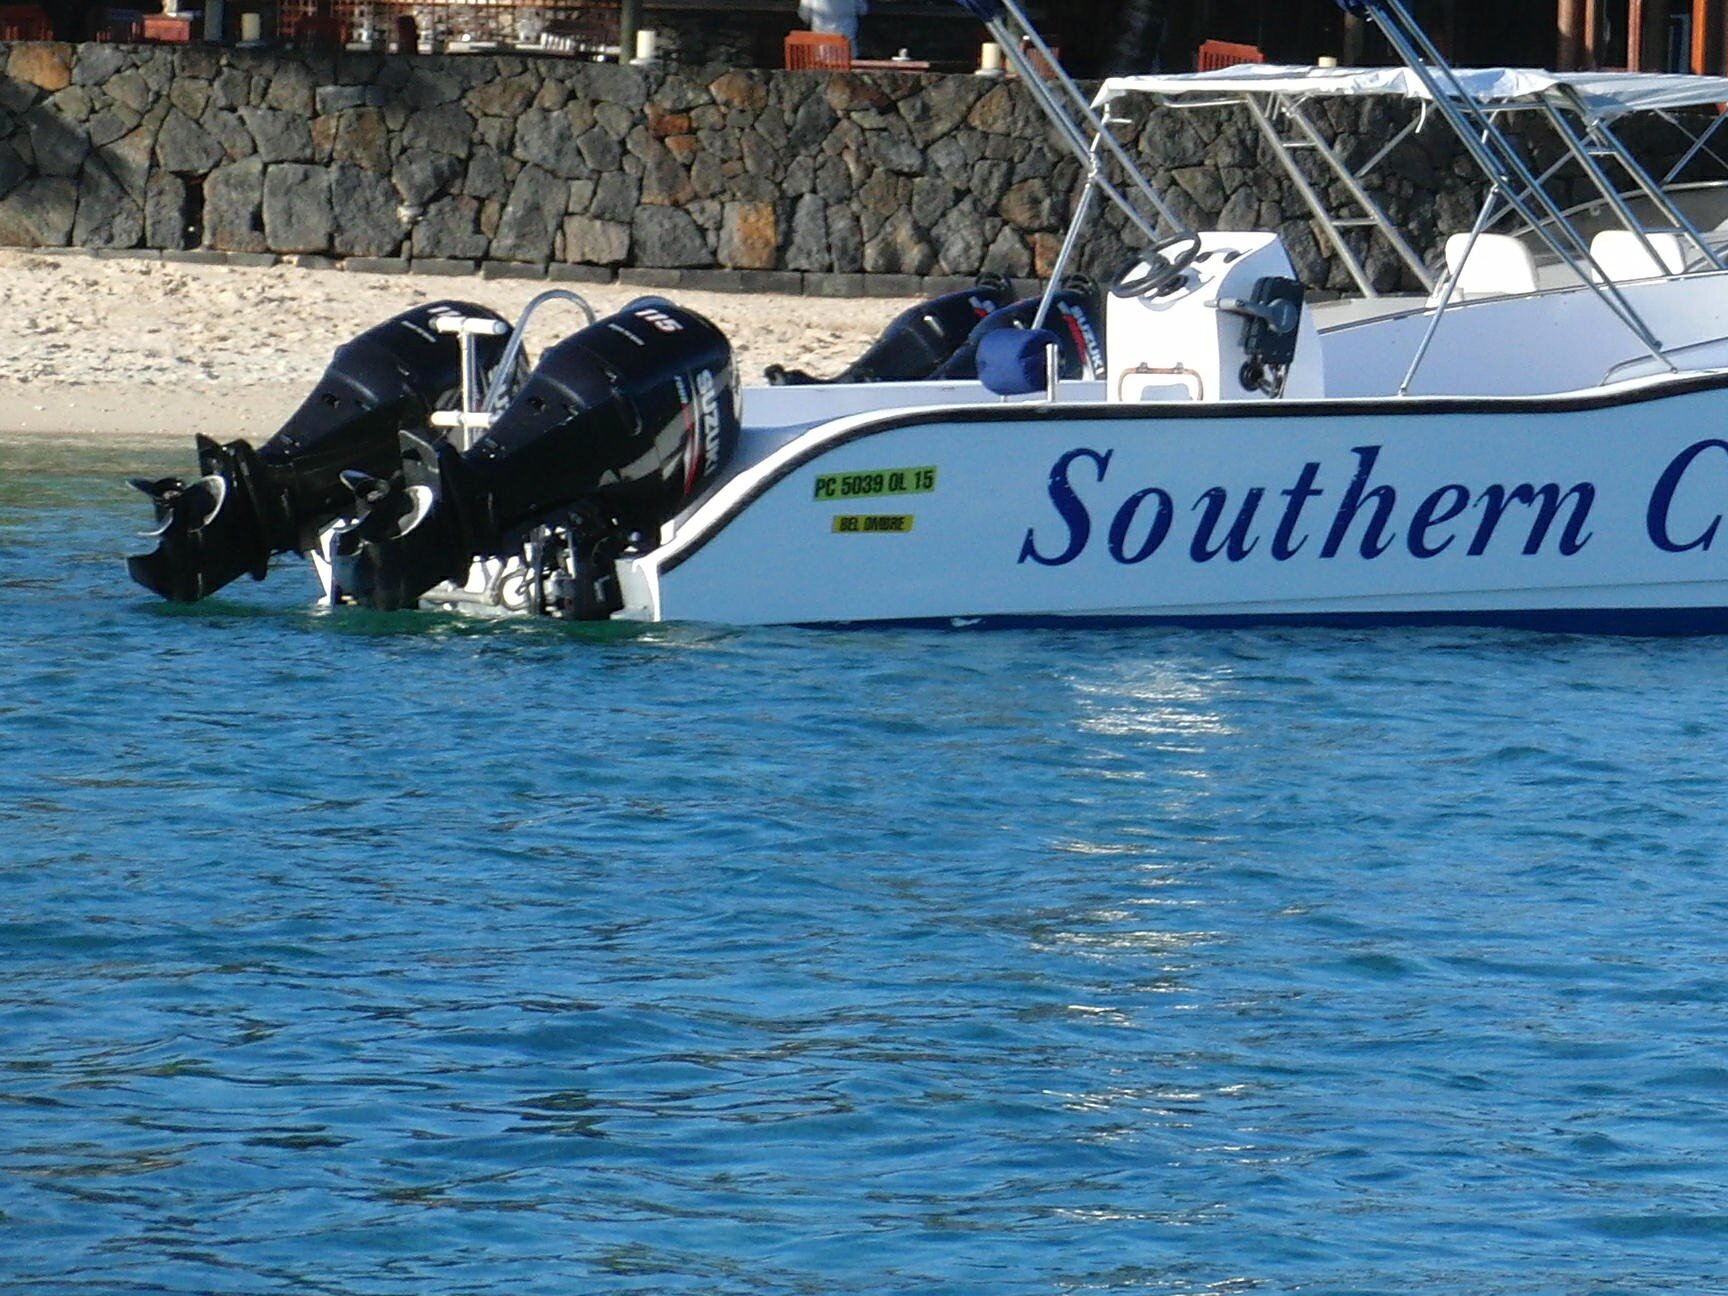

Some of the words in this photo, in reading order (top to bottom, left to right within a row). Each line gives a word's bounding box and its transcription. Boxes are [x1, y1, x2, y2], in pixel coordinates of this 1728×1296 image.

[634, 308, 684, 333] 115
[696, 369, 721, 477] SUZUKI
[814, 477, 837, 498] PC
[841, 474, 884, 495] 5039
[914, 470, 934, 490] 15
[1018, 446, 1595, 566] Southern
